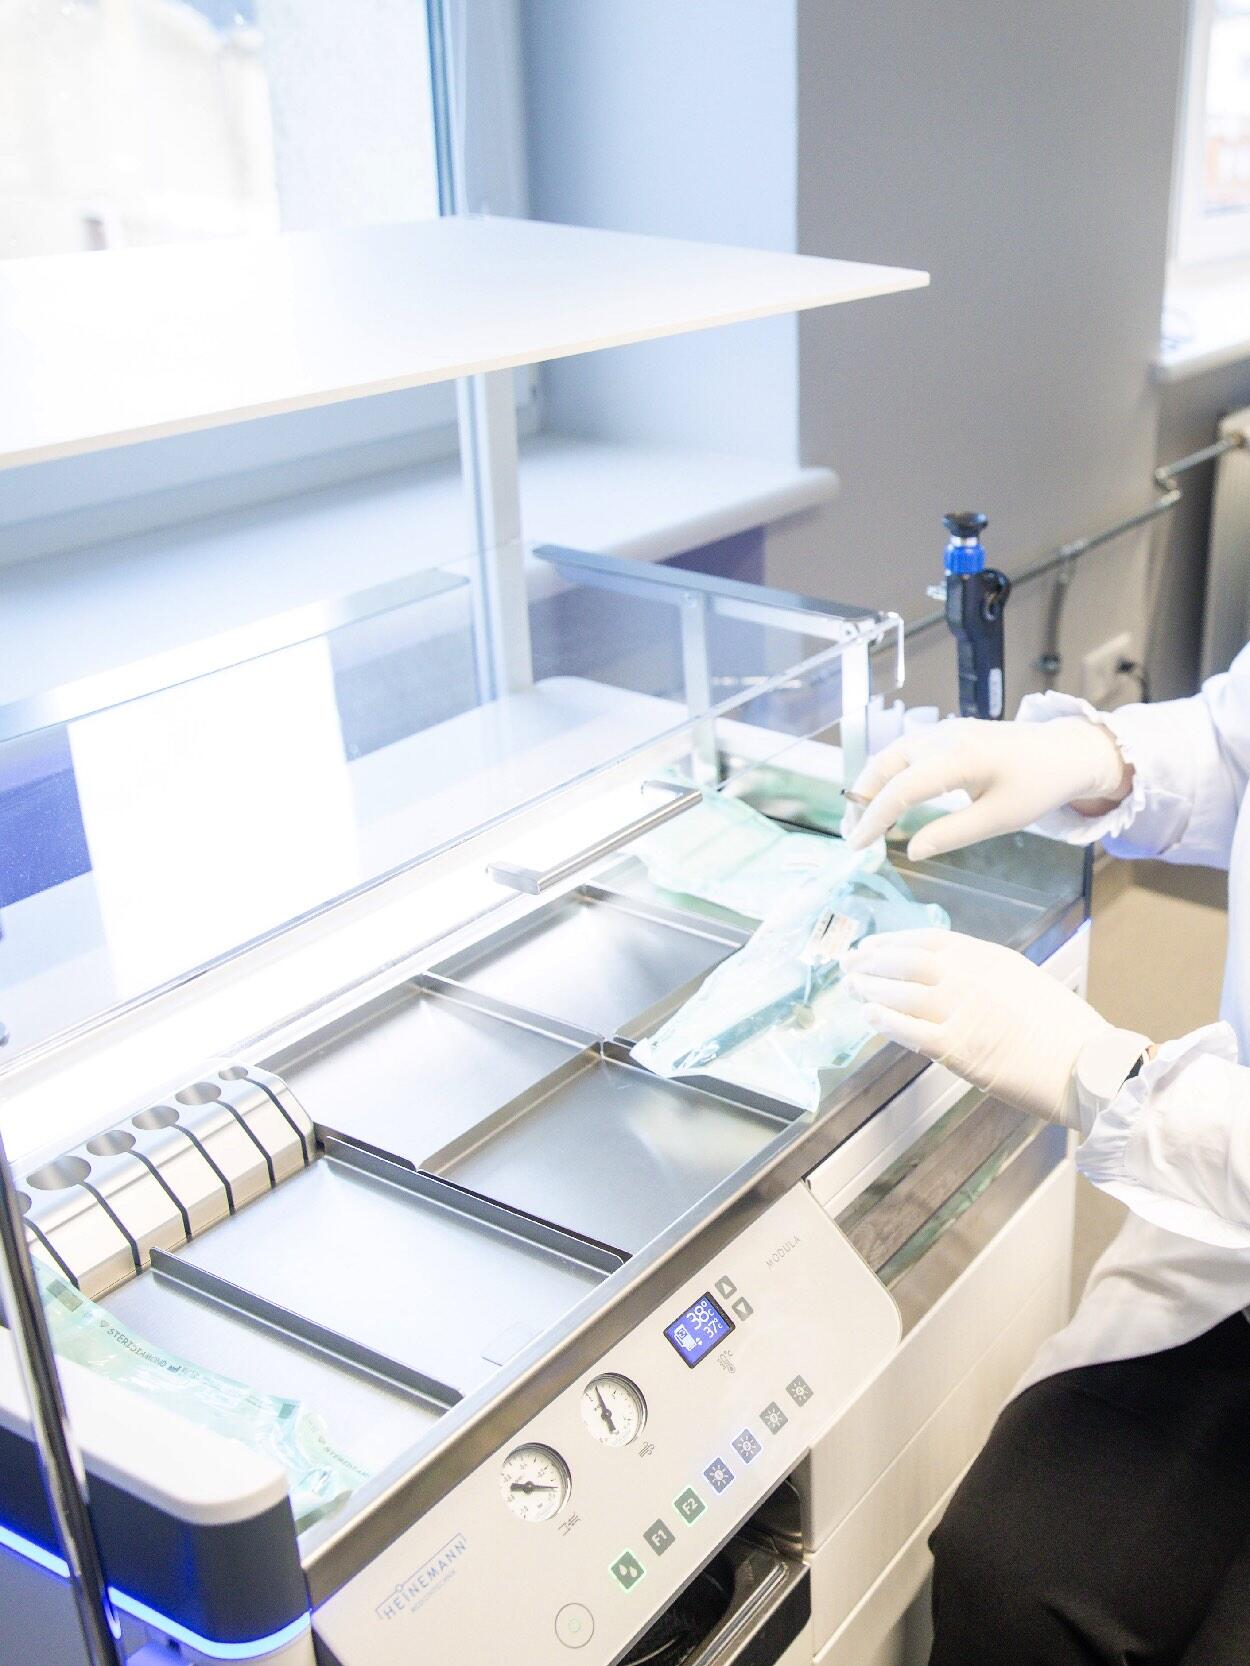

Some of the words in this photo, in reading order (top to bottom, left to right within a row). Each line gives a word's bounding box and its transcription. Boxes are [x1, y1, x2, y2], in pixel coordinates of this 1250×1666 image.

[766, 1231, 801, 1271] MODULA
[682, 1498, 698, 1515] F2
[651, 1529, 668, 1546] F1
[383, 1541, 466, 1620] HEINEMANN
